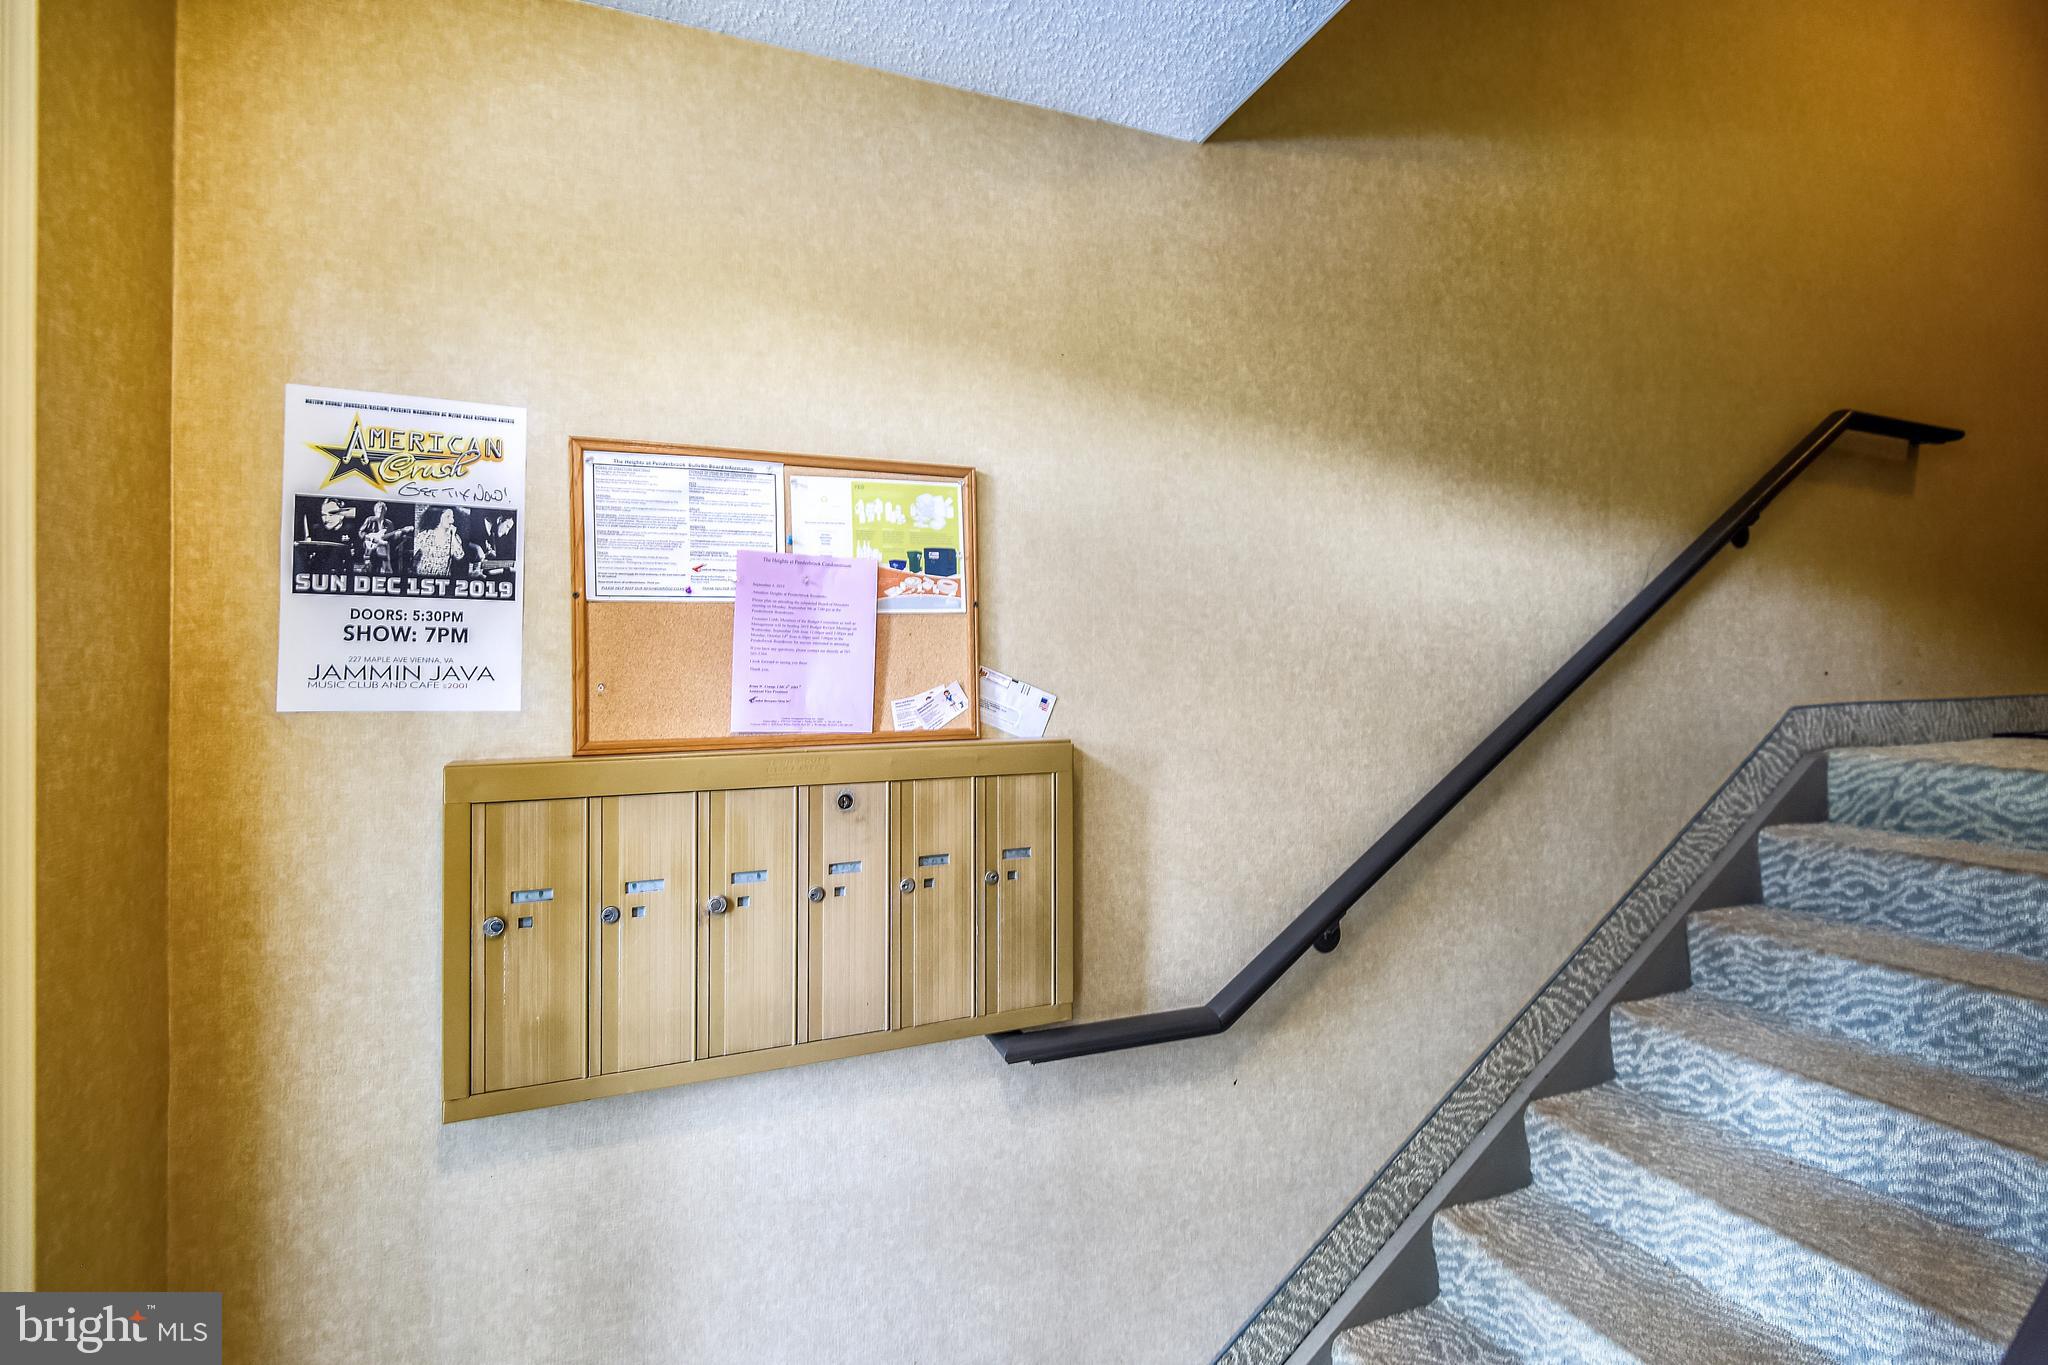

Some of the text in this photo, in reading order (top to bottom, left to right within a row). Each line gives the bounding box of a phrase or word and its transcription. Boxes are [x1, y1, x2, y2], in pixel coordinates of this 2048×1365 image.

[341, 420, 504, 465] AMERICAN
[378, 450, 481, 483] Crush
[398, 482, 439, 497] GET
[295, 573, 513, 598] SUN DEC 1ST 2019
[350, 608, 464, 623] DOORS: 5:30PM
[343, 625, 469, 643] SHOW: 7PM
[308, 664, 496, 681] JAMMIN JAVA
[307, 680, 345, 689] MUSIC
[348, 681, 380, 689] CLUB
[381, 681, 407, 689] AND
[410, 681, 440, 689] CAFE
